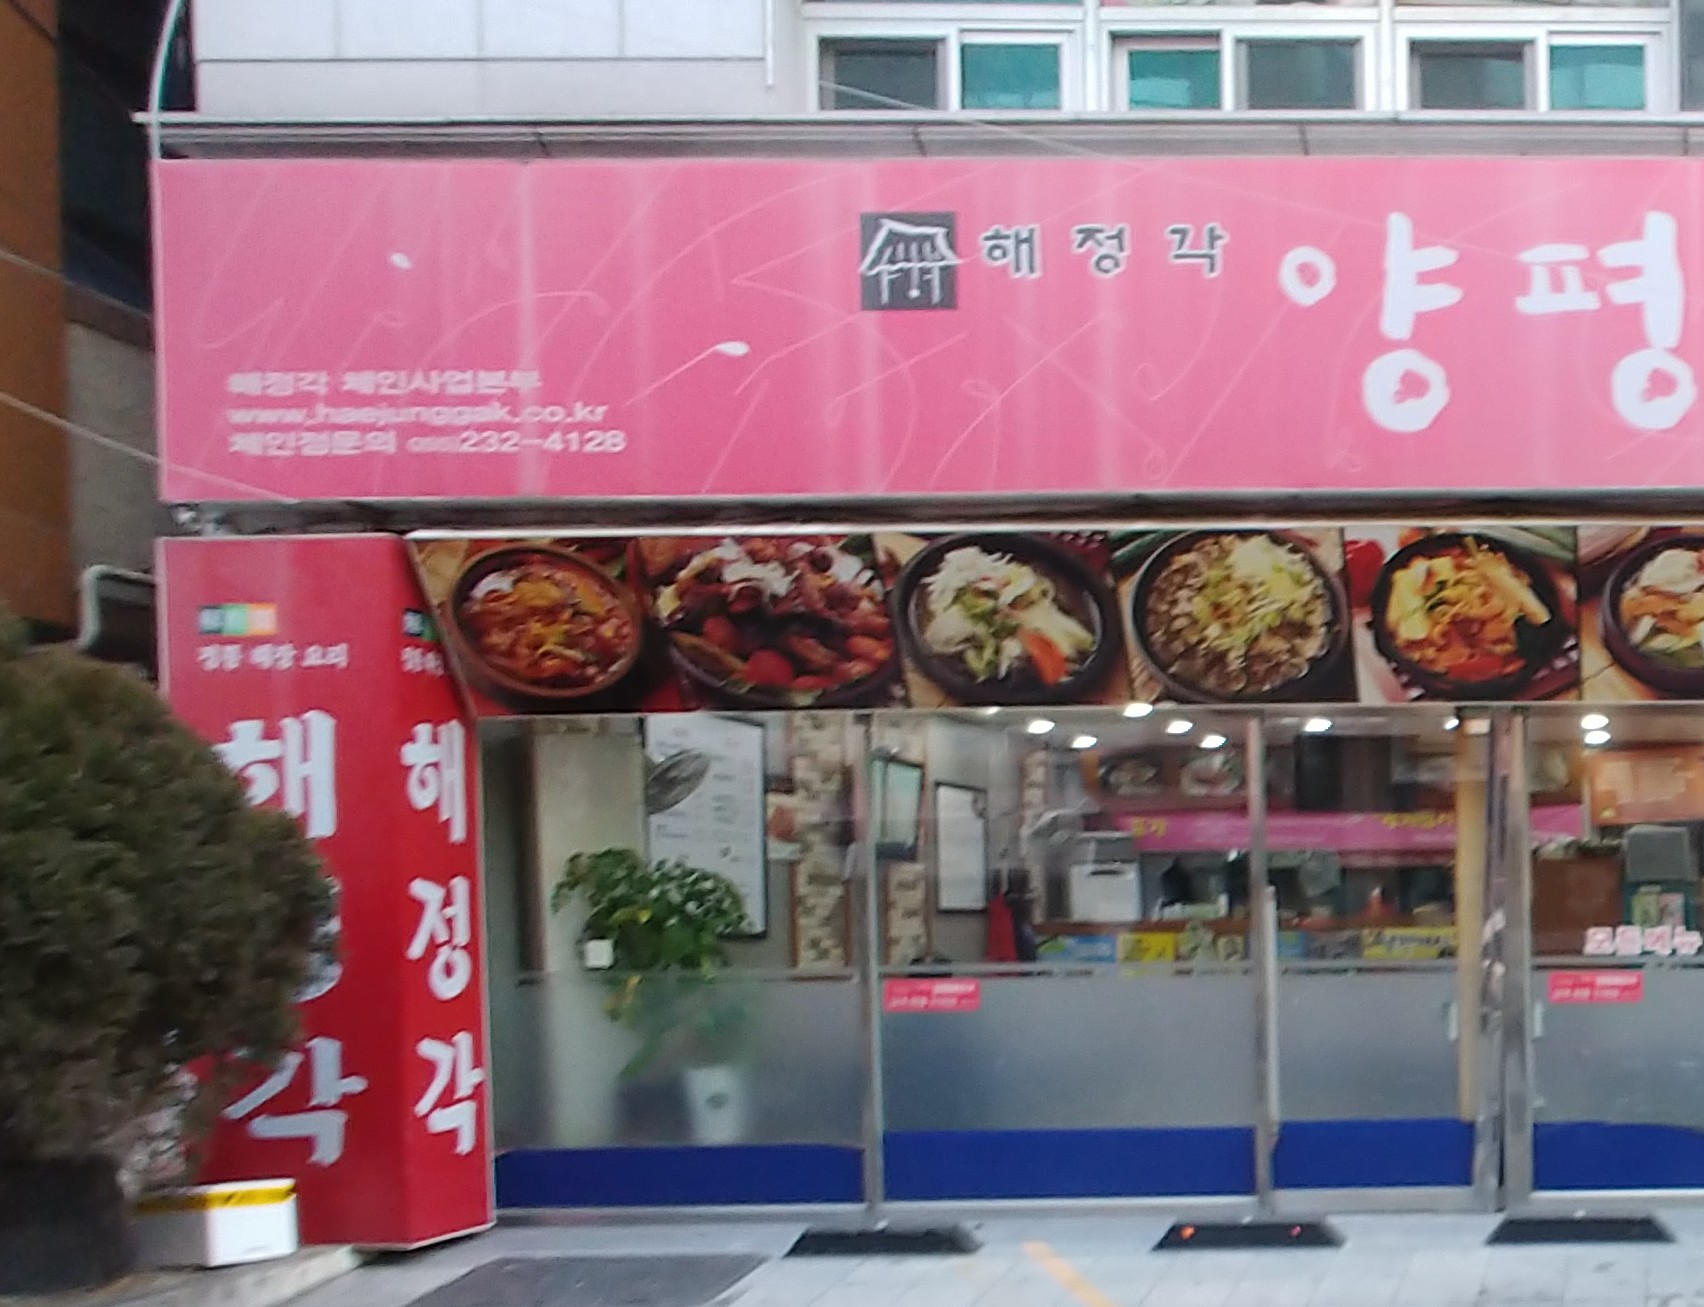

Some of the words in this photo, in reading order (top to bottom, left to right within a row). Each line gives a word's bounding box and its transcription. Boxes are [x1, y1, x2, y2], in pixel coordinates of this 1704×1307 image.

[982, 223, 1229, 280] 해정각
[1279, 211, 1697, 434] 양평
[213, 709, 370, 1166] 해각
[401, 718, 486, 1155] 해정각
